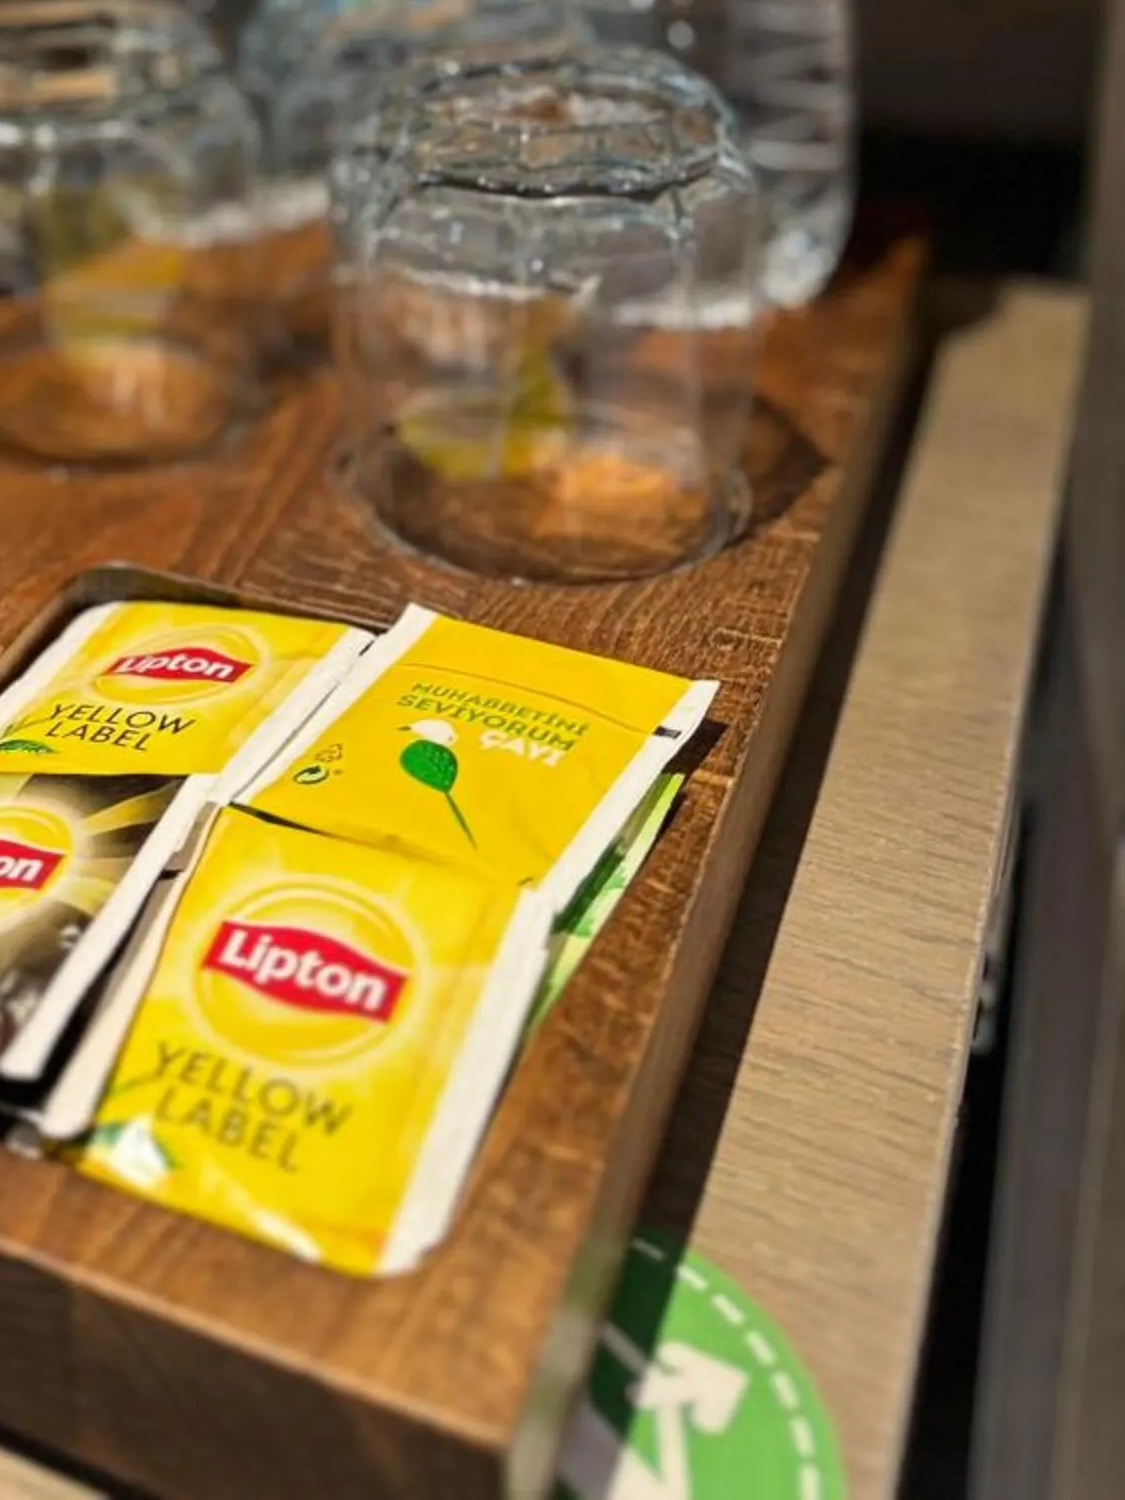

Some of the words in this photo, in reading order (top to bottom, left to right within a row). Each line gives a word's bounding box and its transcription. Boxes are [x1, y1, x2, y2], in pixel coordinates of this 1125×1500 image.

[117, 649, 236, 680] Lipton
[45, 721, 154, 751] LABEL
[48, 702, 197, 736] YELLOW
[218, 928, 390, 1011] Lipton
[152, 1039, 353, 1139] YELLOW
[154, 1088, 300, 1175] LABEL
